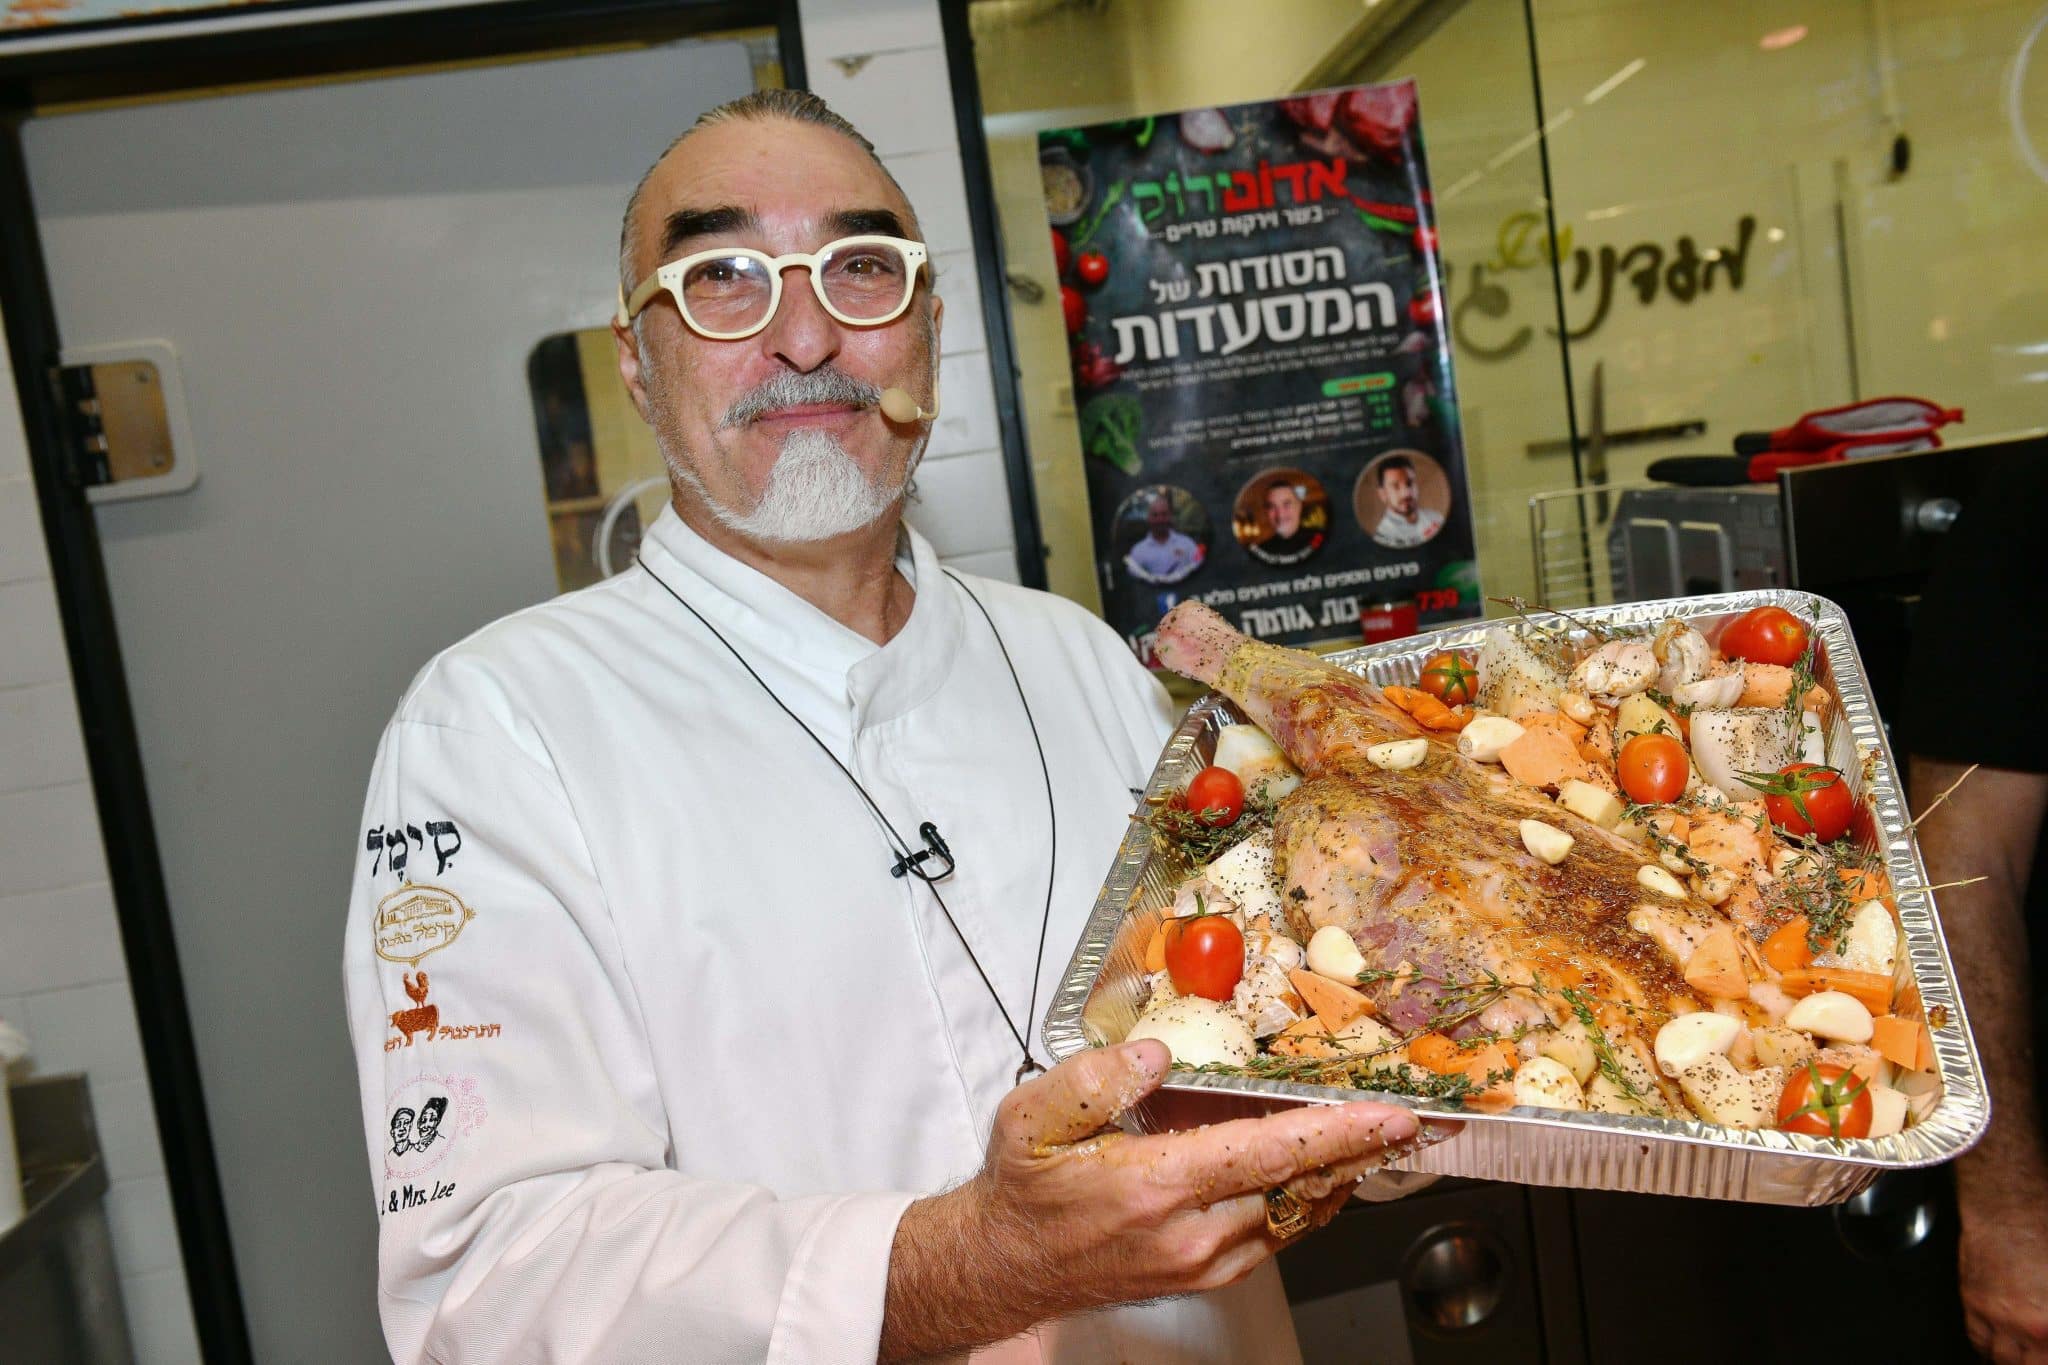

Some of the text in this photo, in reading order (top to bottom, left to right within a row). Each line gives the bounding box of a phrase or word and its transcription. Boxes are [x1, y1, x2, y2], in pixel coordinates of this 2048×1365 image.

[1165, 205, 1325, 242] בשר וירקות טריים
[1150, 246, 1347, 305] הסודות של
[1111, 281, 1398, 365] המסעדות
[1240, 604, 1315, 638] גורמה
[389, 1189, 399, 1212] &
[402, 1184, 427, 1210] Mrs.
[430, 1181, 457, 1201] Lee
